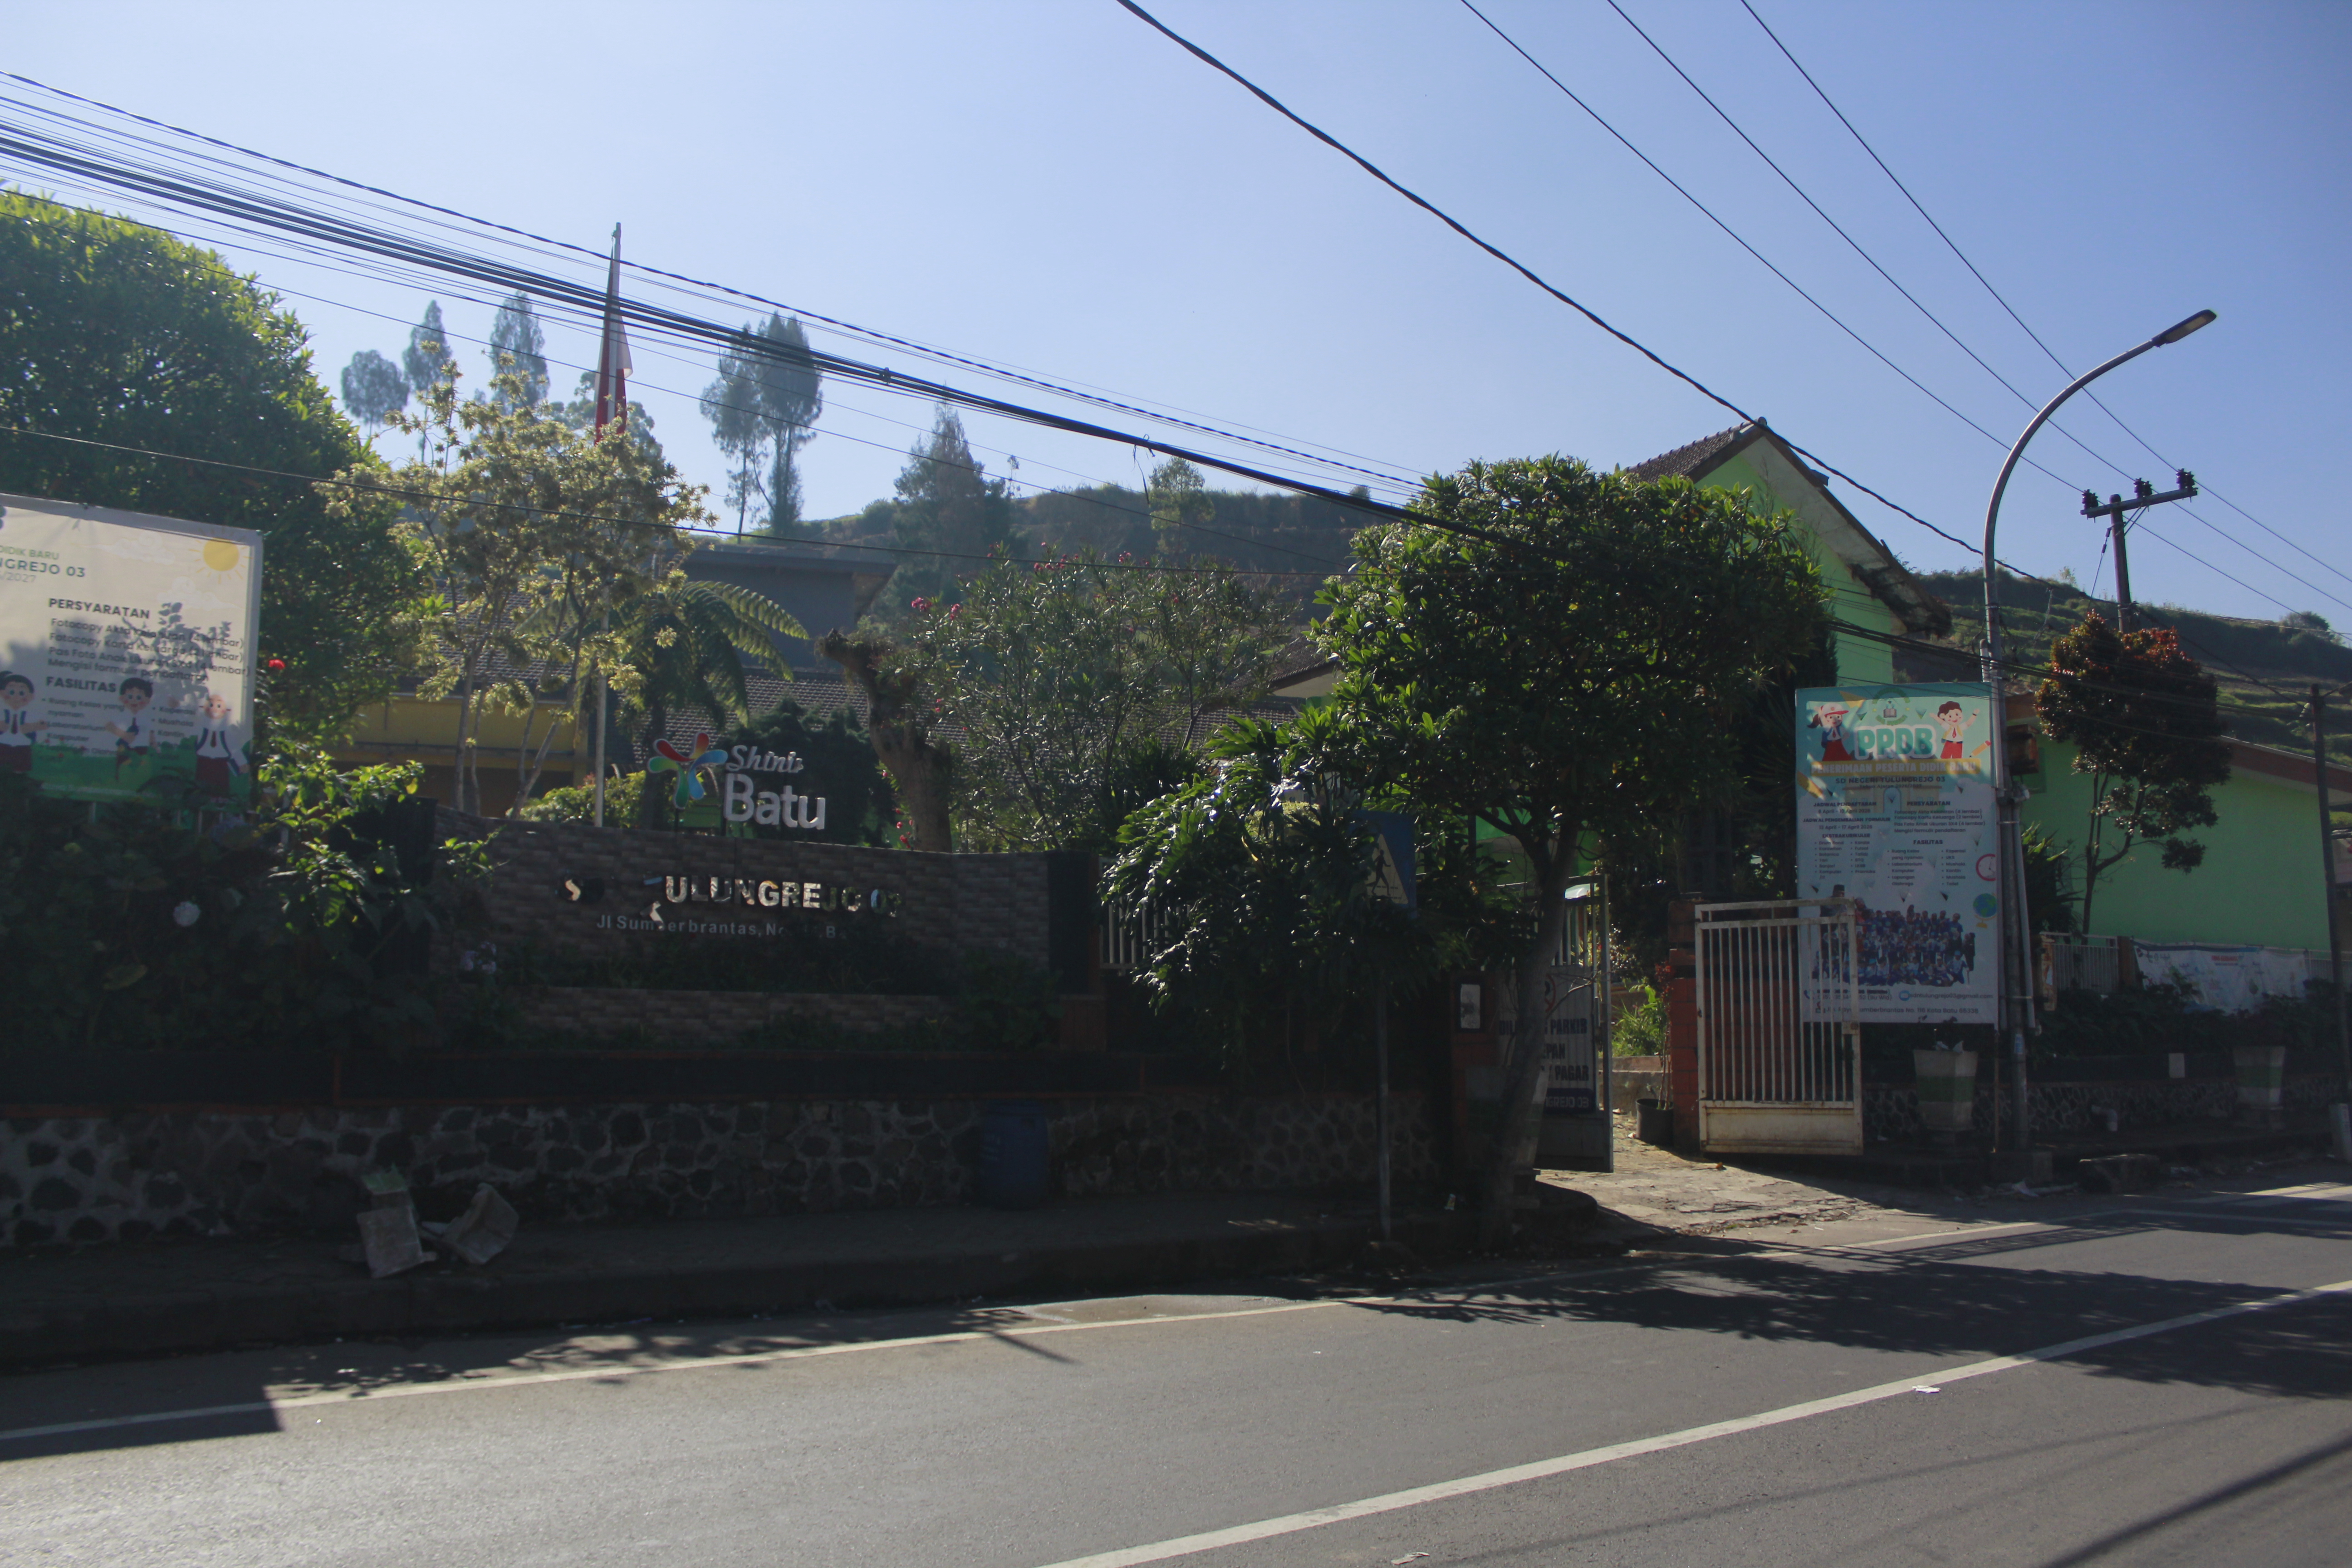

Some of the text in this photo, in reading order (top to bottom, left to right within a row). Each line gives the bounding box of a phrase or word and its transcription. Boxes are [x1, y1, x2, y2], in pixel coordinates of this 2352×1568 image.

[29, 549, 59, 560] BARU
[66, 566, 86, 577] 03
[49, 598, 150, 619] PERSYARATAN
[51, 618, 103, 633] Fotocopy
[49, 632, 101, 647] Fotocopy
[46, 676, 117, 693] FASILITAS
[1856, 725, 1935, 759] PPDB
[1875, 762, 1916, 773] PESERTA
[1920, 762, 1946, 772] DIDIK
[723, 773, 826, 830] Batu
[616, 916, 762, 938] Sumerbrantas,
[1550, 1018, 1588, 1035] PARKIR
[1554, 1064, 1589, 1081] PAGAR
[1577, 1096, 1590, 1108] 03
